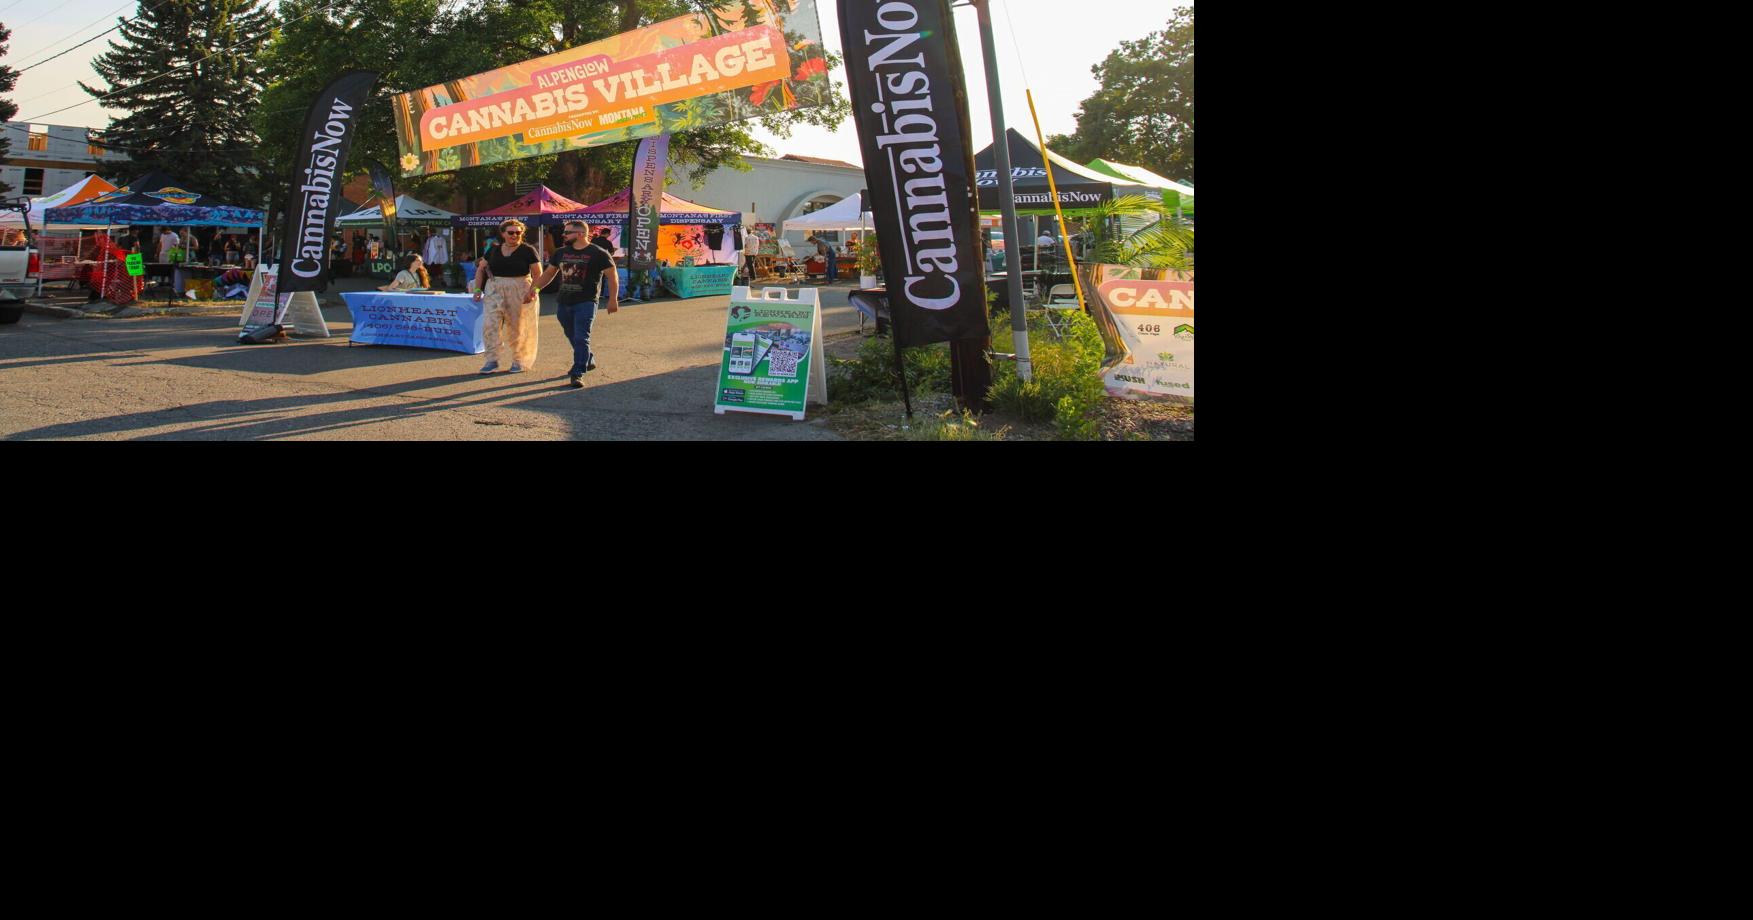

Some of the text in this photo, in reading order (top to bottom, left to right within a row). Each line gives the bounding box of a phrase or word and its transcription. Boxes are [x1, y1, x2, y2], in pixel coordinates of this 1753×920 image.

[536, 58, 610, 90] ALPENGLOW
[429, 36, 776, 140] CANNABIS VILLAGE
[598, 106, 645, 126] MONTANA
[528, 118, 593, 139] CannabisNow
[864, 0, 960, 310] CannabisNo
[291, 97, 353, 279] CannabisNow
[1014, 191, 1102, 204] annaisNow
[636, 206, 651, 250] OPEN
[1108, 288, 1194, 310] CAN
[361, 305, 459, 317] LIONHEART
[368, 313, 453, 326] CANNABIS
